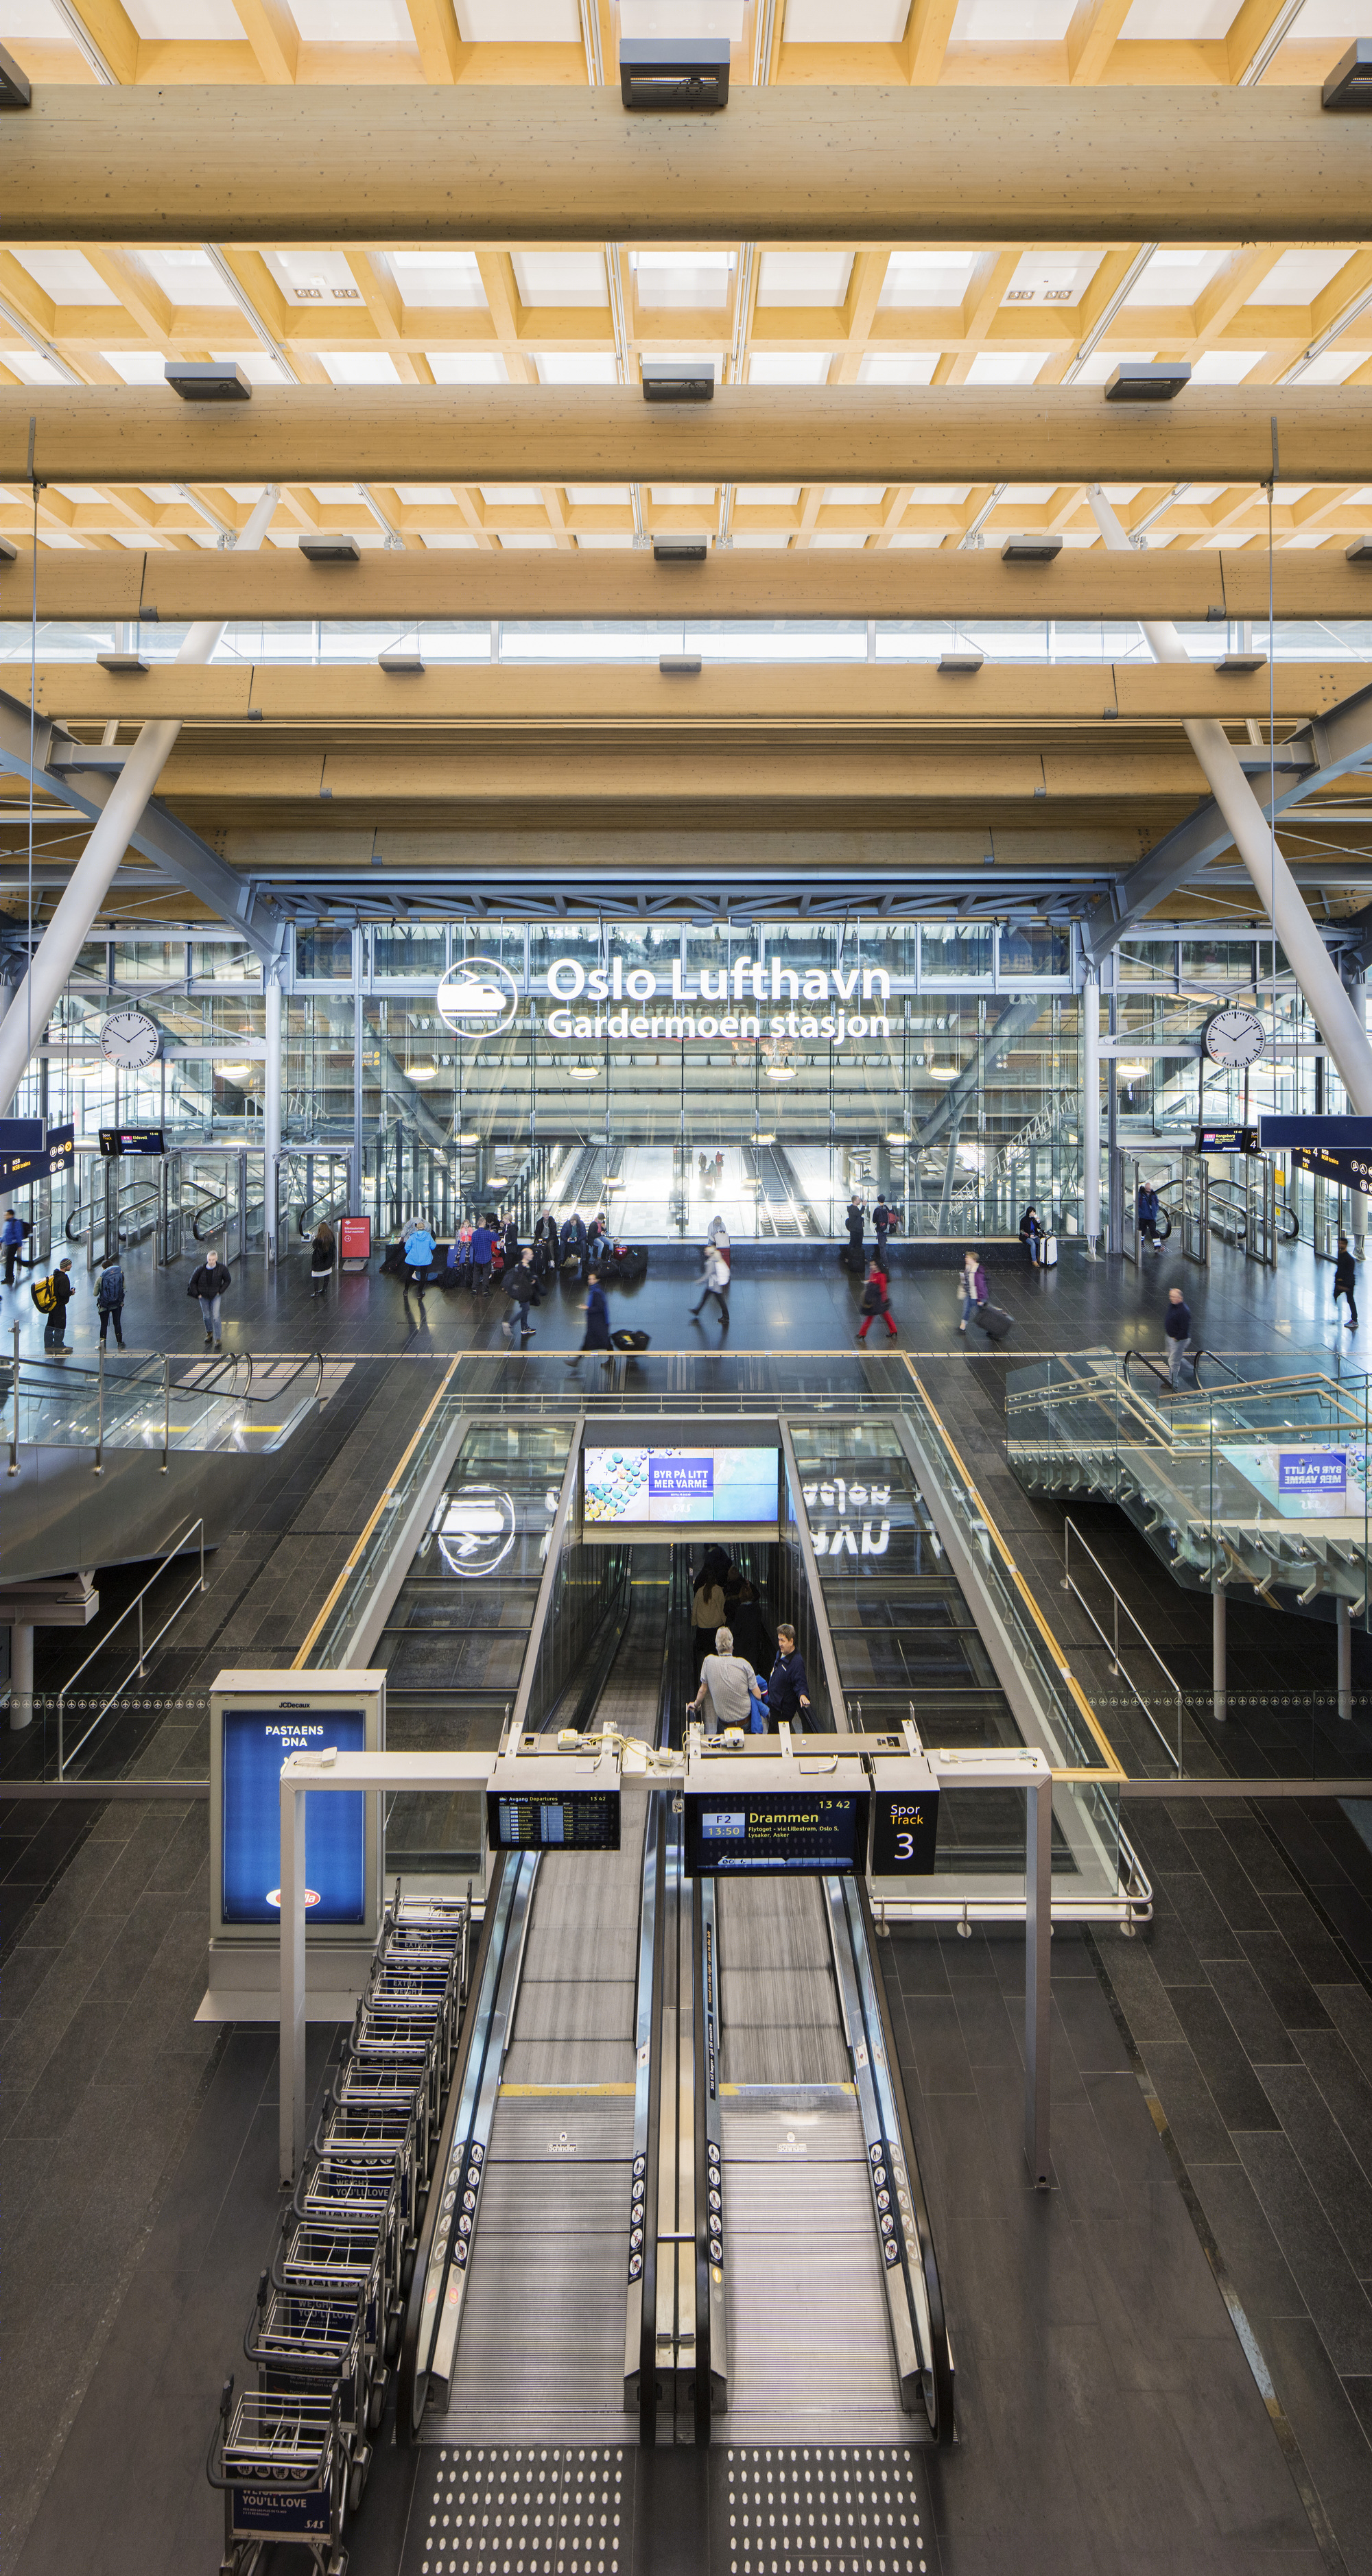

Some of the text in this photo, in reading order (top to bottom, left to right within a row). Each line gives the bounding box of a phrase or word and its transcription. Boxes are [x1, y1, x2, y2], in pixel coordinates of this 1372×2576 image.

[547, 956, 890, 1000] Oslo Lufthavn
[547, 1007, 890, 1046] Gardermoen stasjon
[105, 1142, 110, 1151] 1
[1250, 1140, 1256, 1149] 4
[1313, 1148, 1318, 1157] 4
[1329, 1157, 1339, 1165] trains
[3, 1163, 7, 1174] 1
[654, 1469, 708, 1479] BYR PÅ LITT
[654, 1479, 707, 1488] MER VARME
[670, 1503, 692, 1512] SAS
[265, 1726, 324, 1736] PASTAENS
[282, 1737, 308, 1747] DNA
[819, 1800, 850, 1809] 13 42
[890, 1804, 920, 1817] Spor
[749, 1813, 818, 1824] Drammen
[890, 1814, 923, 1824] Track
[709, 1827, 740, 1835] 13:50
[894, 1833, 913, 1860] 3
[298, 2310, 355, 2319] YOU'LL LOVE
[242, 2496, 307, 2507] YOU'LL LOVE
[305, 2520, 324, 2529] SAS
